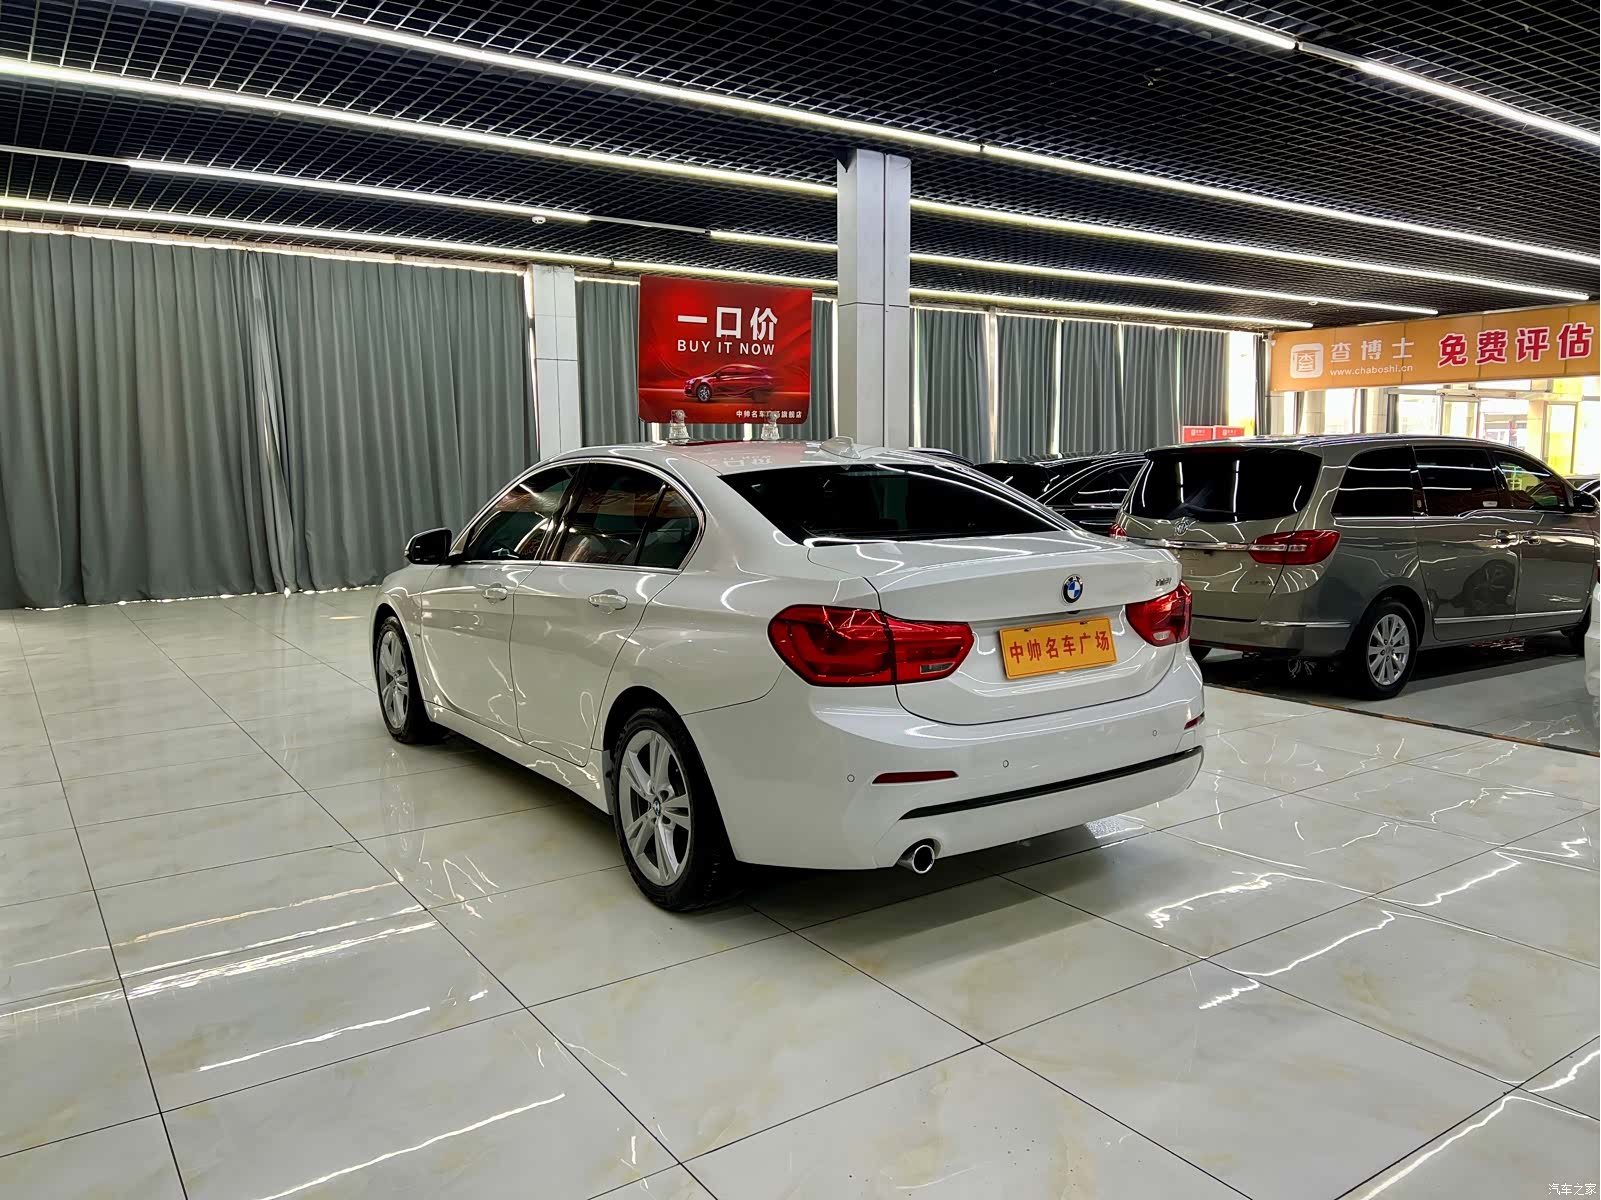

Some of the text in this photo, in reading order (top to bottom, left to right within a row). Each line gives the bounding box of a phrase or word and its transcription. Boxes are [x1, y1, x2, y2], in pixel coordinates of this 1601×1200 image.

[677, 306, 778, 340] 一口价
[677, 339, 775, 356] BUY IT NOW
[1330, 337, 1415, 363] 查博士
[1437, 323, 1595, 368] 免费评估
[1329, 364, 1413, 376] www.chaboshi.cn
[1009, 630, 1110, 664] 中帅名车广场
